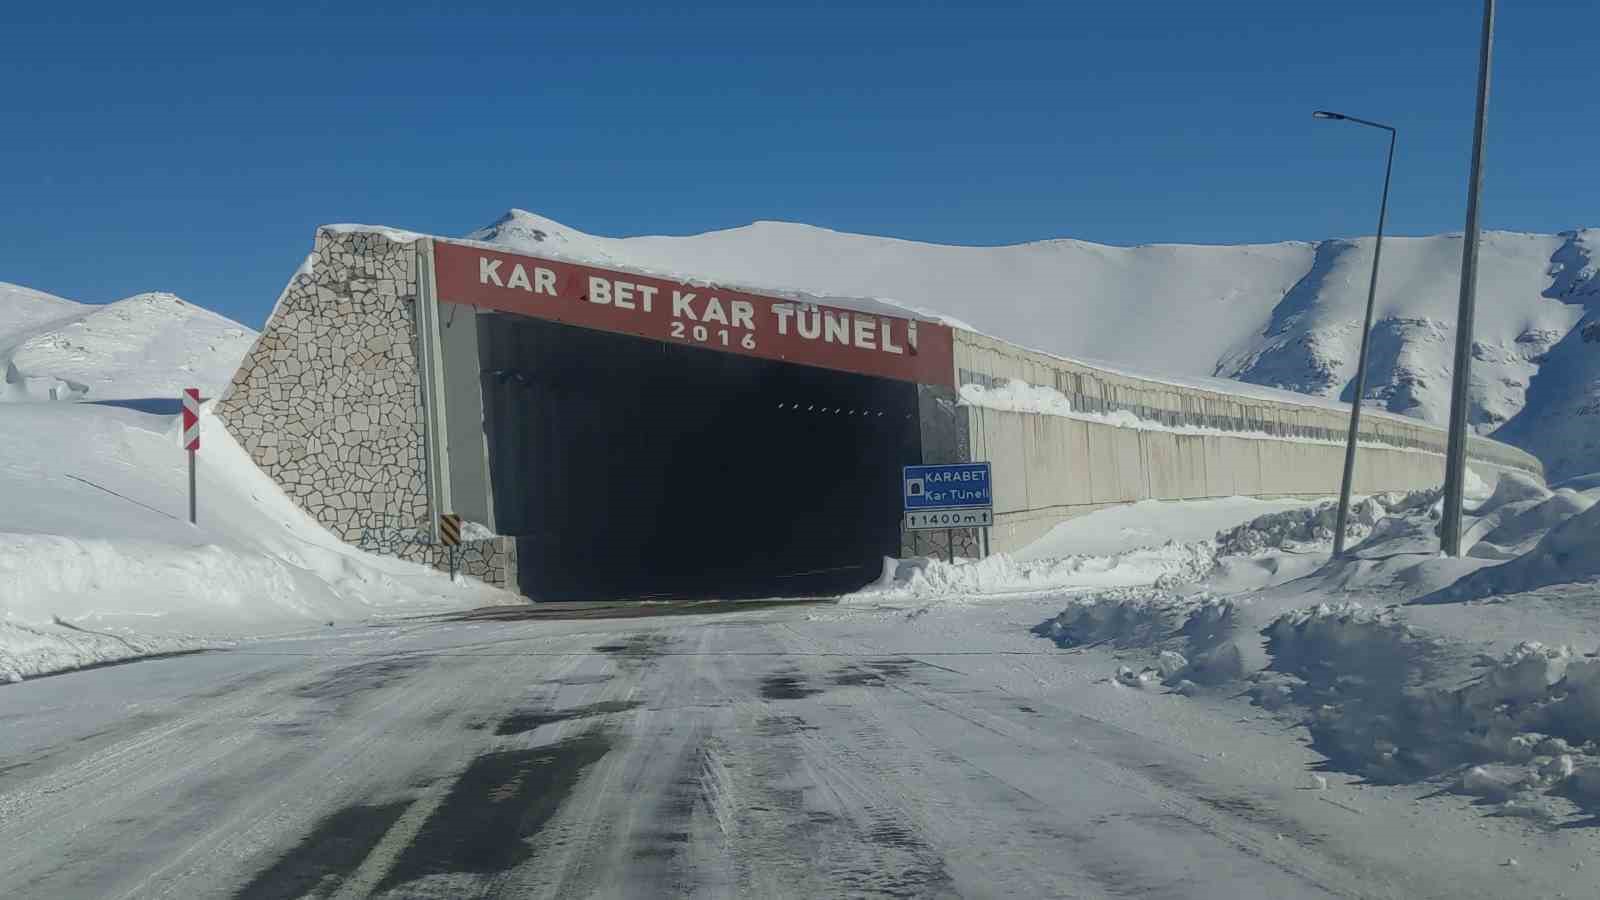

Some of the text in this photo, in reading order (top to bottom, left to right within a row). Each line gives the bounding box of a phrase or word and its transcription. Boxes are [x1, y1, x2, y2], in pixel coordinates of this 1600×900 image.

[671, 290, 755, 331] KAR
[670, 321, 756, 351] 2016
[925, 471, 986, 482] KARABET
[925, 490, 948, 502] Kar
